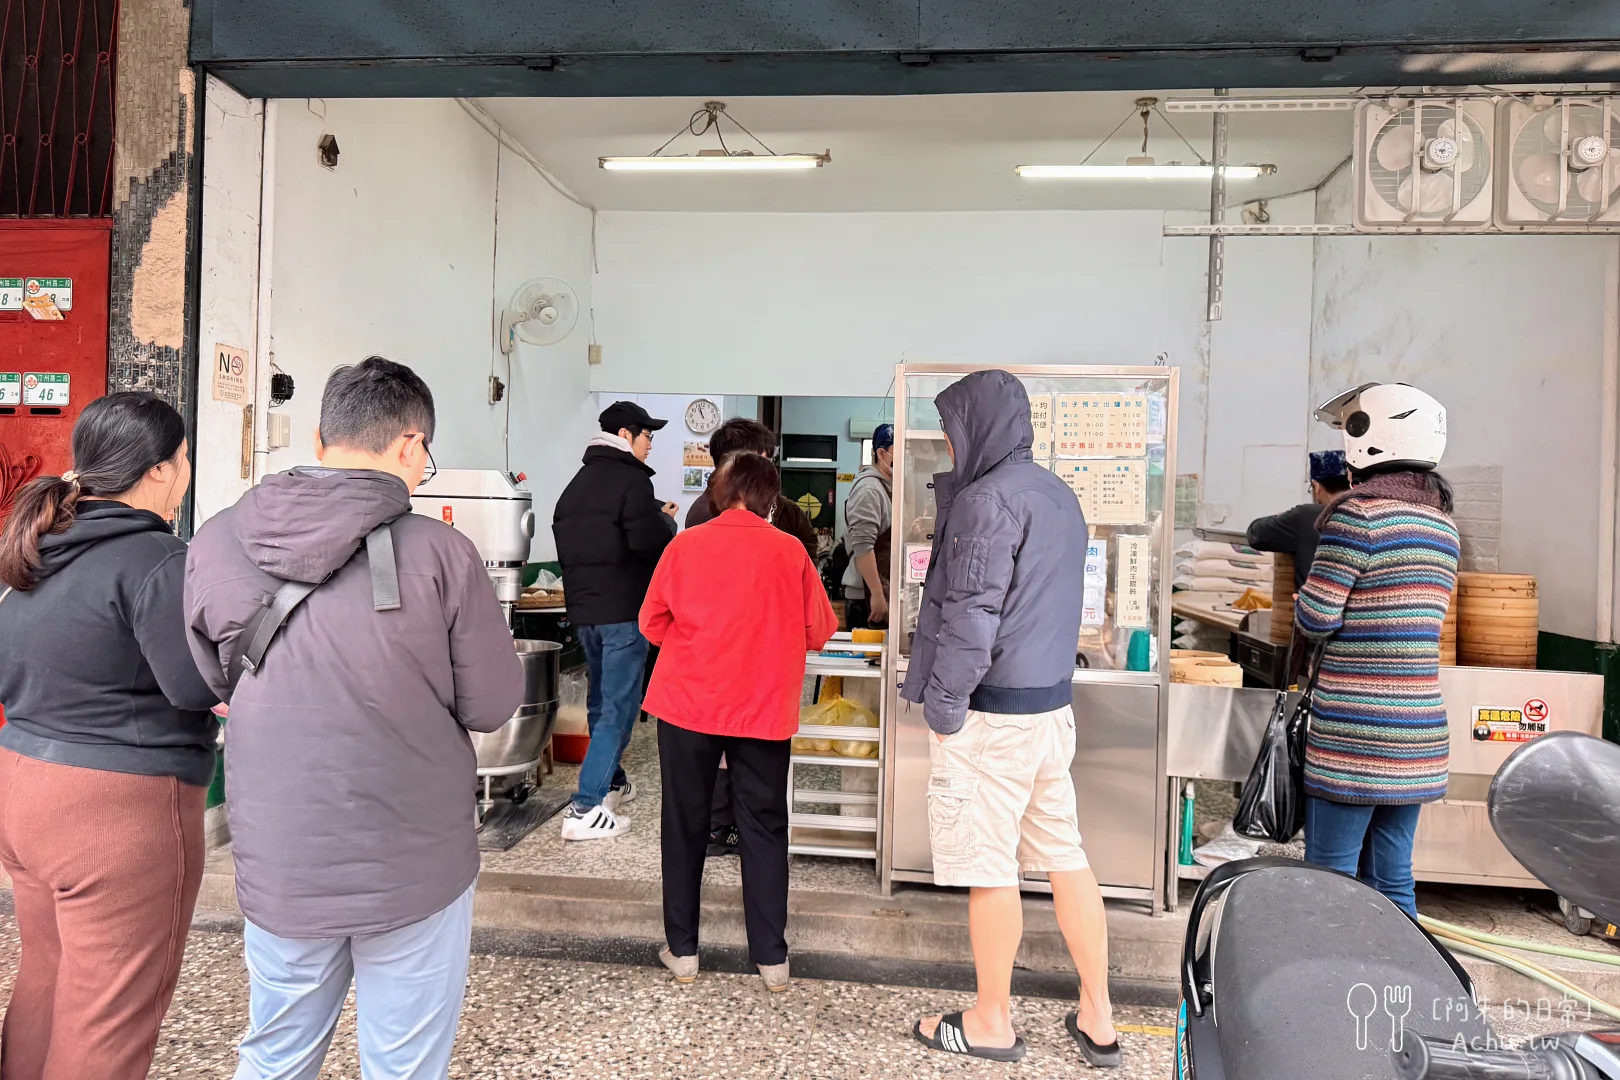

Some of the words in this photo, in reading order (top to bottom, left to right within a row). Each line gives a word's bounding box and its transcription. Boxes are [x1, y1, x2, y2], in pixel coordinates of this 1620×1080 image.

[37, 374, 68, 382] 汀州路二段
[218, 374, 243, 384] SMOKING
[38, 388, 54, 401] 46
[1061, 400, 1142, 408] 包子預定出爐時間
[1479, 708, 1523, 723] 高溫危險
[1518, 722, 1546, 732] 勿觸碰
